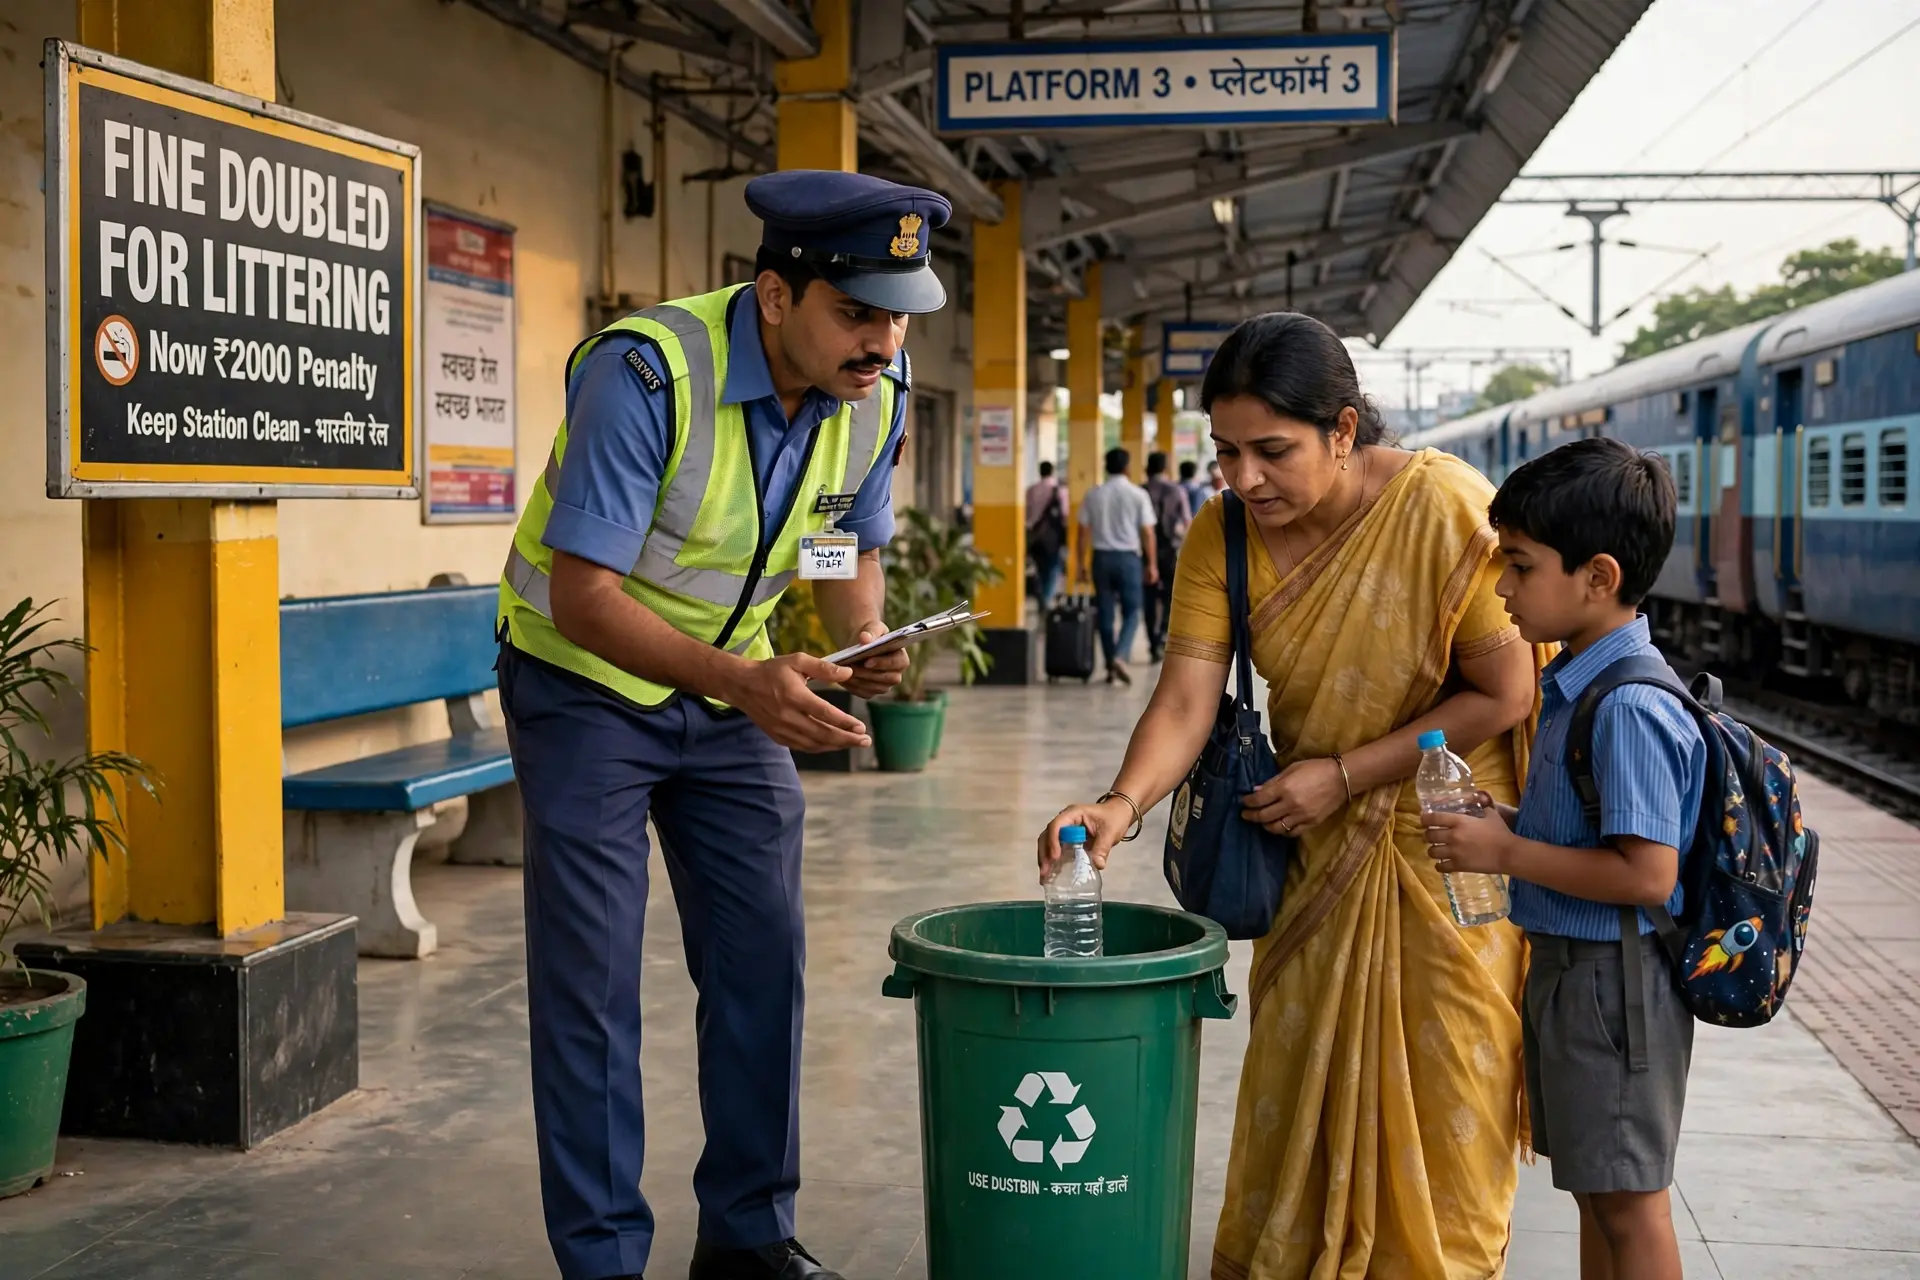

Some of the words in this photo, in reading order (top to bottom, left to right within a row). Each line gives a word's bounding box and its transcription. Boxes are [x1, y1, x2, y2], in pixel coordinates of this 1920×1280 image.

[964, 67, 1140, 103] PLATFORM
[1152, 66, 1171, 98] 3
[1208, 54, 1332, 97] प्लेटफॉर्म
[1342, 62, 1362, 94] 3
[104, 119, 206, 216] FINE
[219, 147, 390, 252] DOUBLED
[99, 219, 190, 308] FOR
[203, 238, 390, 336] LITTERING
[149, 329, 207, 376] Now
[213, 337, 292, 385] ₹2000
[298, 346, 378, 401] Penalty
[441, 352, 476, 382] स्वच्छ
[127, 402, 178, 444] Keep
[182, 405, 248, 440] Station
[252, 410, 300, 442] Clean
[314, 411, 366, 445] भारतीय
[367, 413, 390, 447] रेल
[435, 391, 470, 420] स्वच्छ
[815, 559, 843, 570] STAFF
[968, 1171, 989, 1189] USE
[991, 1175, 1040, 1195] DUSTBIN
[1050, 1182, 1082, 1196] कचरा
[1084, 1175, 1105, 1197] यहाँ
